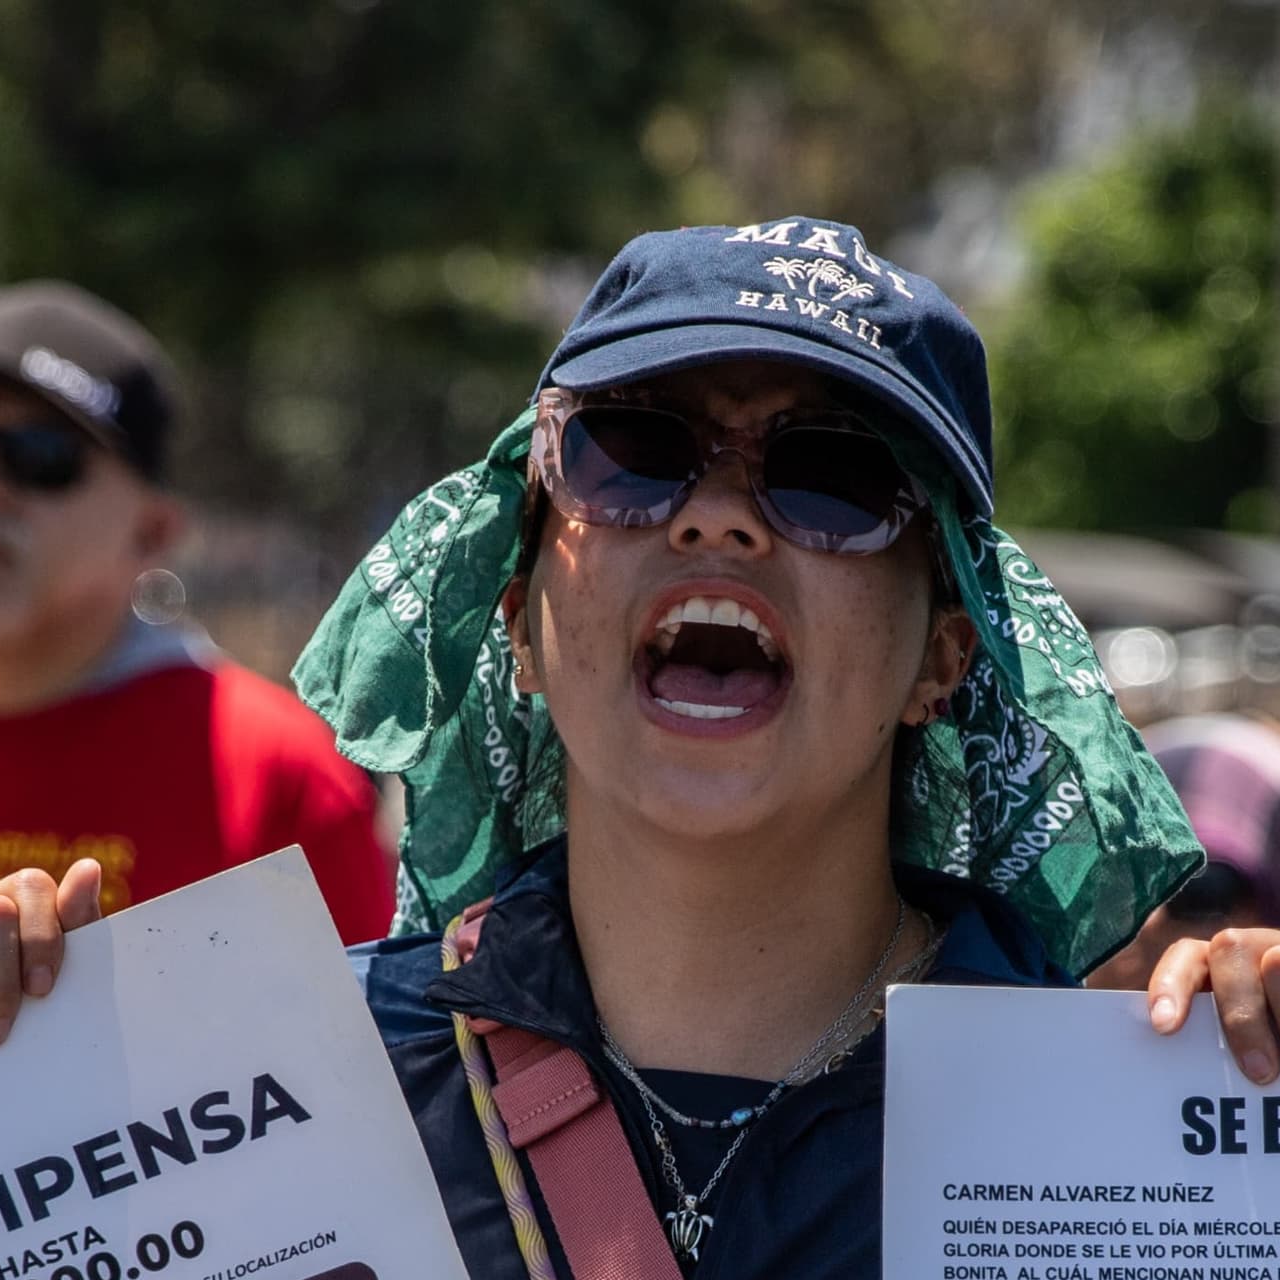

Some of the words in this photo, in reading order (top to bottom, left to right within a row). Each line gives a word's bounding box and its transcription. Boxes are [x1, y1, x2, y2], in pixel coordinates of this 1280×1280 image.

[735, 291, 882, 350] HAWAII
[1181, 1096, 1247, 1156] SE
[942, 1183, 1033, 1201] CARMEN
[1039, 1184, 1136, 1202] ALVAREZ
[1141, 1183, 1214, 1203] NUÑEZ
[942, 1216, 996, 1234] QUIÉN
[1001, 1217, 1127, 1236] DESAPARECIÓ
[1131, 1221, 1154, 1236] EL
[1158, 1217, 1188, 1236] DÍA
[225, 1229, 336, 1280] LOCALIZACIÓN
